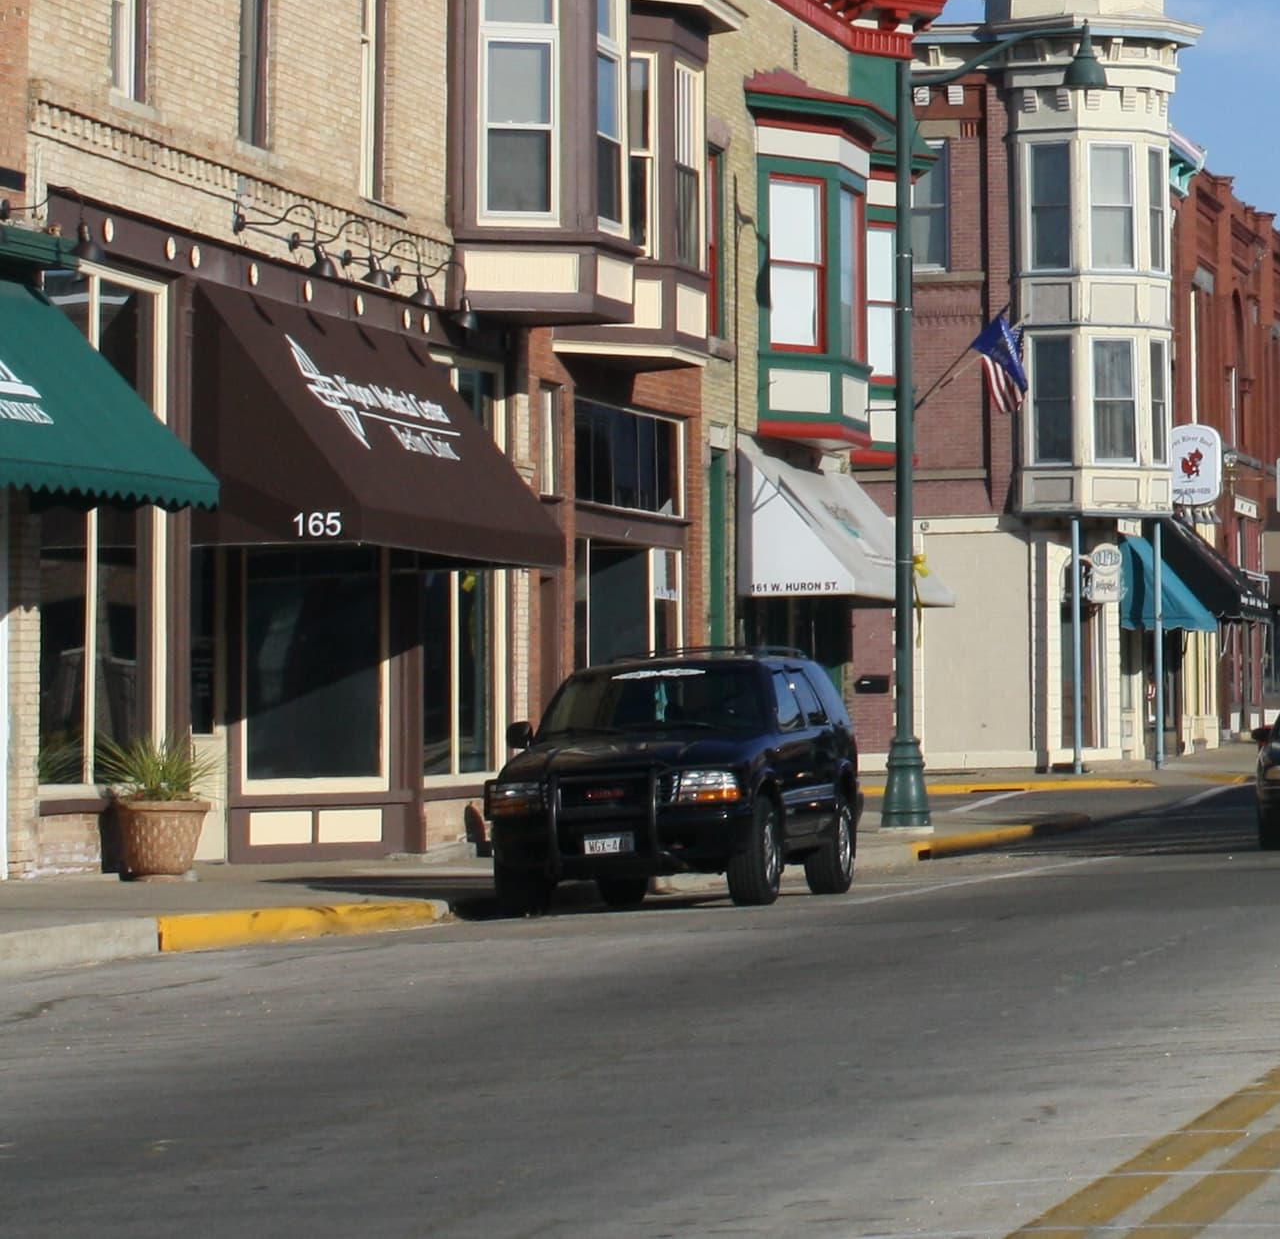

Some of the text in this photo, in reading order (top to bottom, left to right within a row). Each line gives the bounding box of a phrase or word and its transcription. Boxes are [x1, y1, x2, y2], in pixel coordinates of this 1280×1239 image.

[293, 512, 342, 537] 165
[751, 583, 768, 592] 161
[785, 581, 822, 592] HURON
[825, 580, 839, 591] ST.
